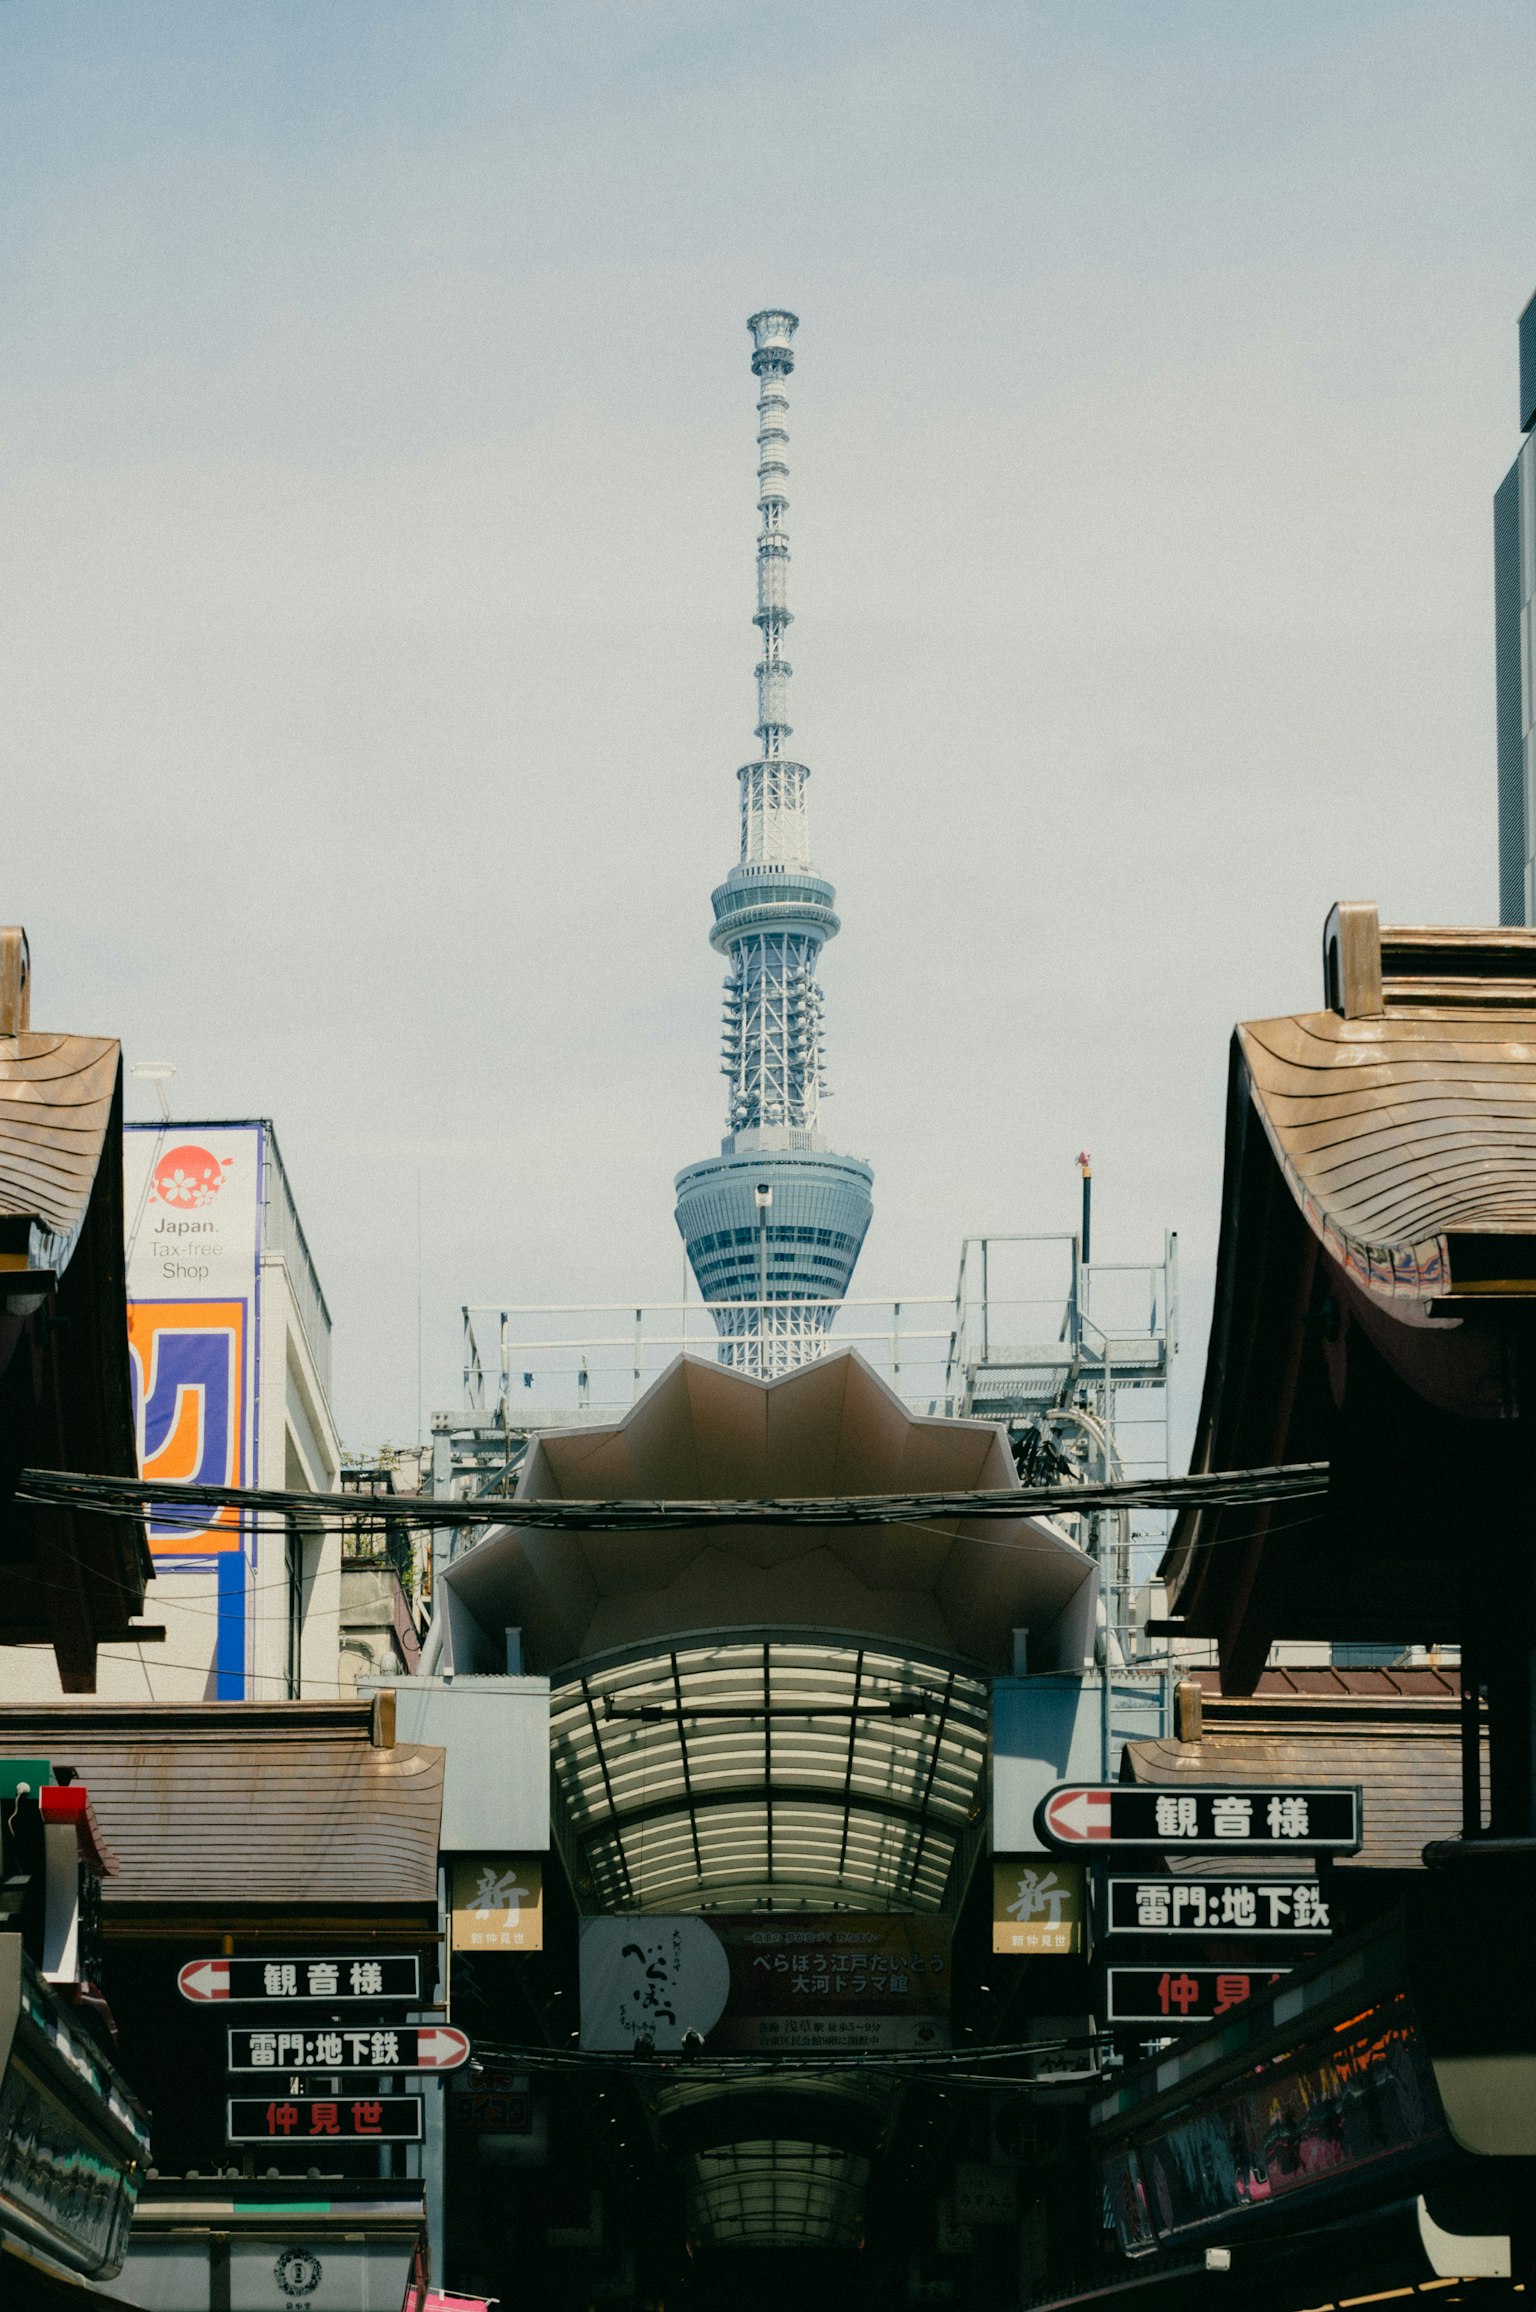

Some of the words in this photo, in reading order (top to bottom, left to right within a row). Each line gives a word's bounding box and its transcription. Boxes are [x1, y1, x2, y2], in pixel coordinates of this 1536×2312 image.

[149, 1241, 223, 1257] Tax-free
[163, 1262, 209, 1281] Shop
[1155, 1795, 1310, 1838] 観音様
[465, 1867, 530, 1928] 新
[1005, 1868, 1072, 1931] 新
[471, 1932, 525, 1945] 新仲見世
[1011, 1934, 1066, 1947] 新仲見世
[752, 1952, 945, 1974] べらぼう江戸たいとう
[263, 1963, 383, 1996] 観音様
[791, 1974, 909, 1994] 大河ドラマ館
[1157, 1973, 1281, 2015] 仲見
[265, 2102, 384, 2135] 仲見世
